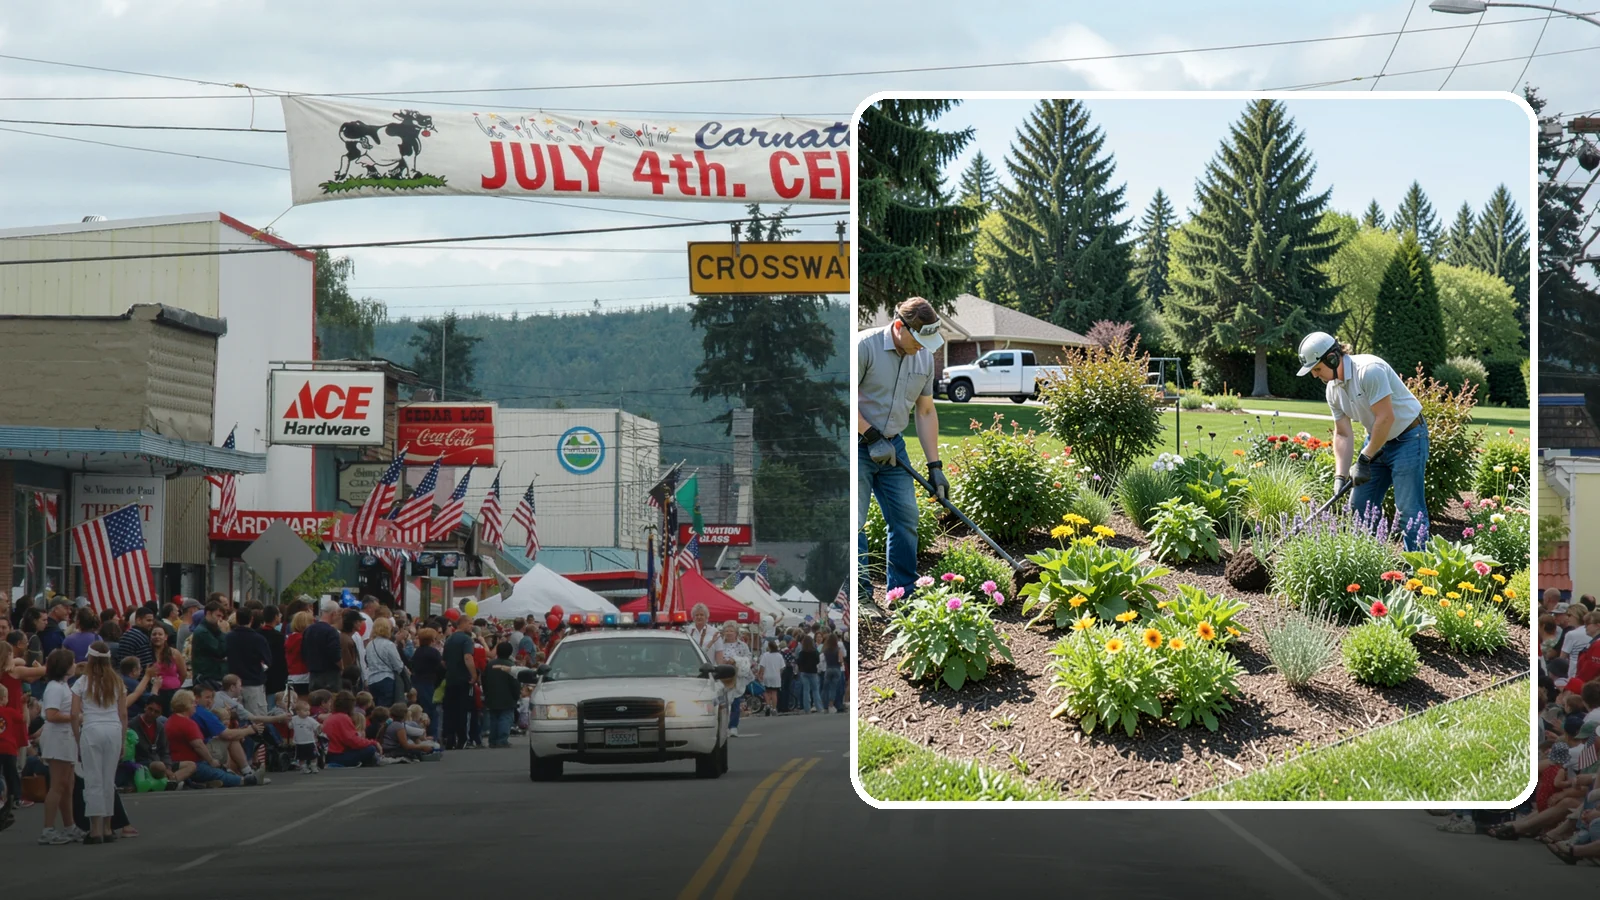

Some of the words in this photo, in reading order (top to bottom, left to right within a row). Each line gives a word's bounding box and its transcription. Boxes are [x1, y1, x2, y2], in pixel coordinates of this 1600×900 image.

[481, 141, 605, 192] JULY
[632, 150, 746, 197] 4th.
[697, 254, 850, 280] CROSSWA
[282, 380, 373, 420] ACE
[406, 409, 452, 422] CEDAR
[283, 421, 371, 436] Hardware
[354, 467, 385, 480] Simpl
[96, 485, 124, 495] Vincent
[126, 486, 134, 495] de
[137, 486, 155, 495] Paul
[688, 526, 741, 535] CRNATION
[700, 535, 730, 543] GLASS
